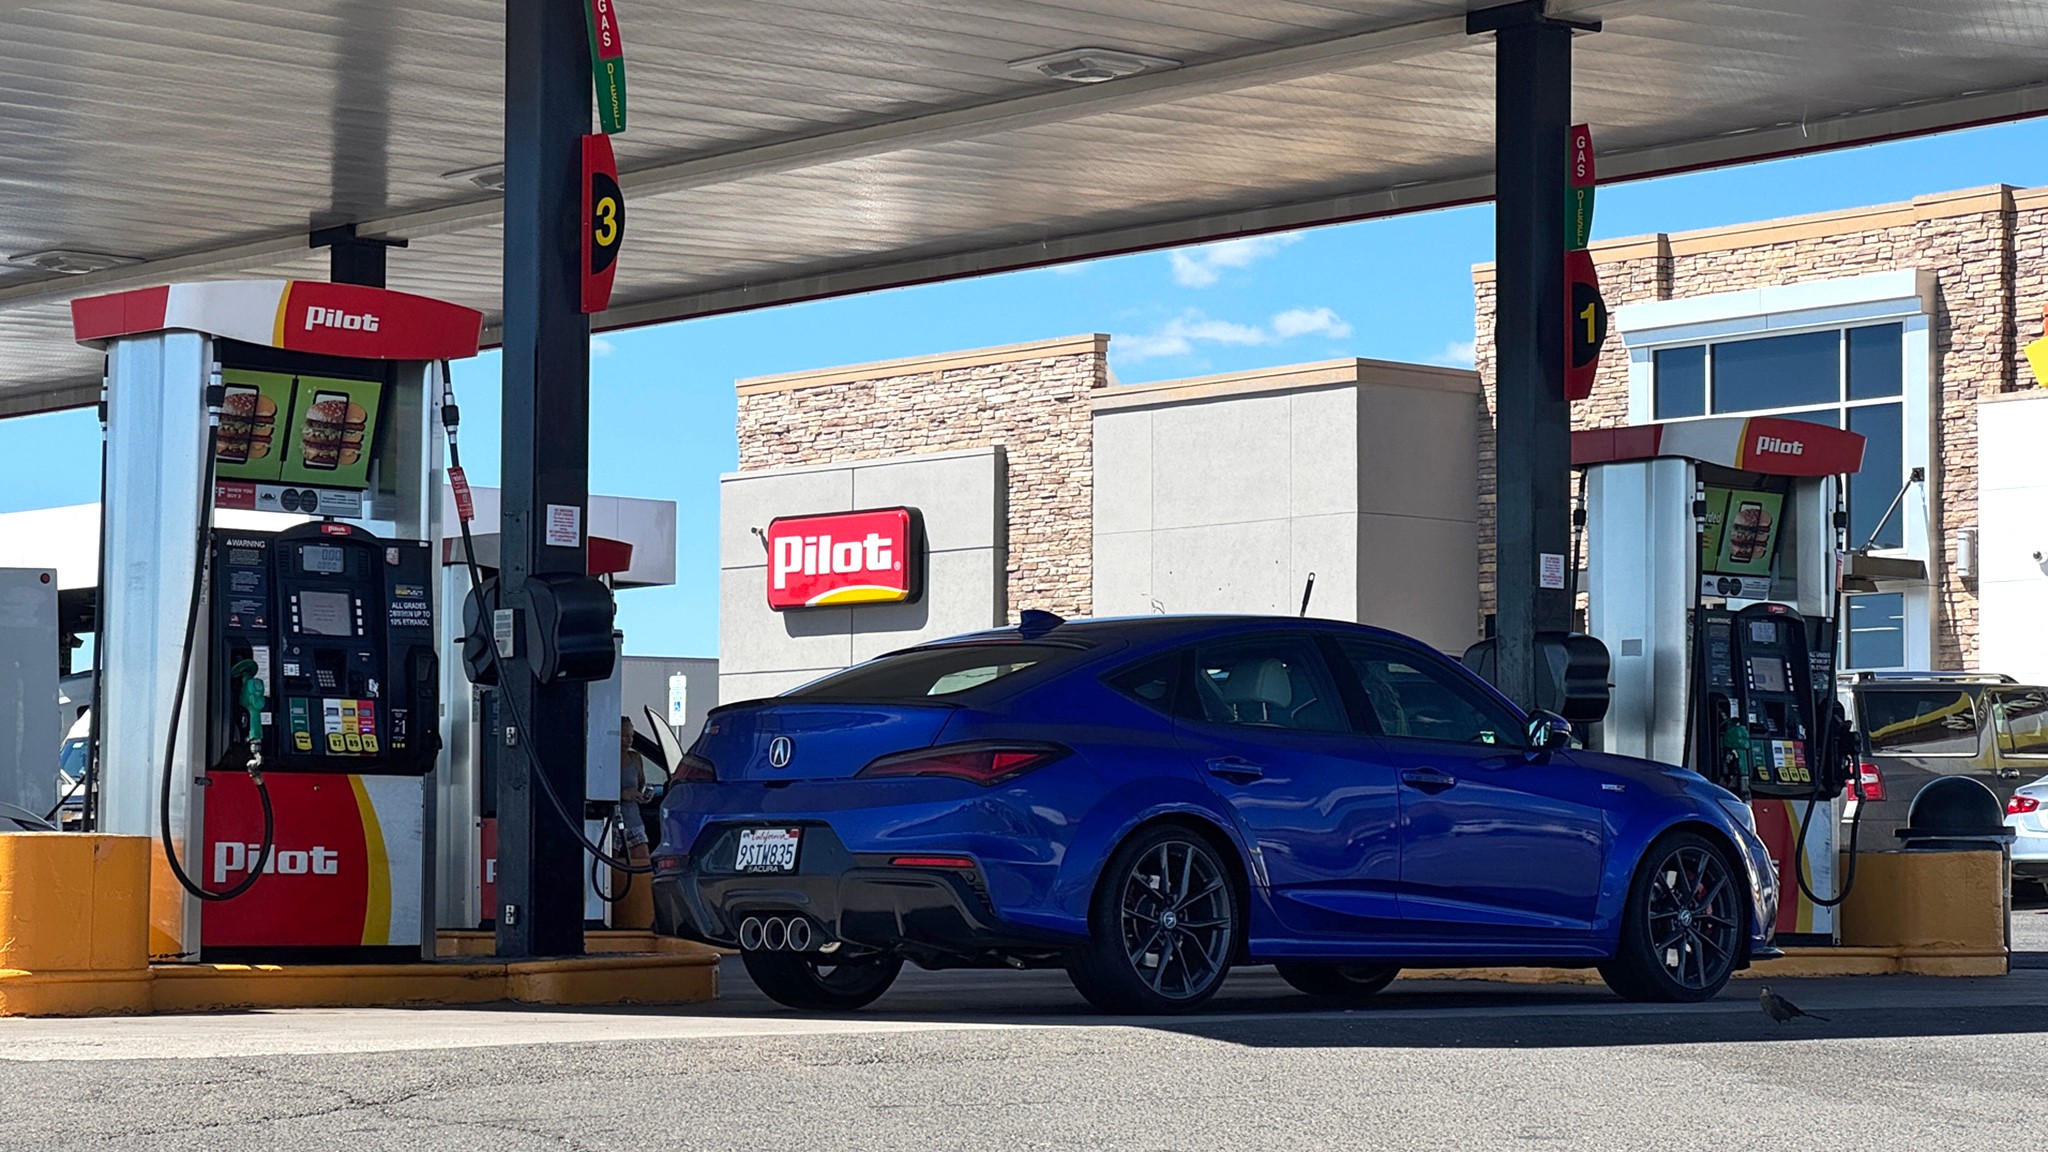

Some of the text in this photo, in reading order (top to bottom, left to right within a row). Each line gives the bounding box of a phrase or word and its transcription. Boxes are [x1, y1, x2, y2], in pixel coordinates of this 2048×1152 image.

[597, 0, 612, 47] GAS
[606, 62, 622, 129] DIESEL
[1576, 135, 1586, 177] GAS
[595, 196, 617, 246] 3
[304, 305, 380, 332] Pilot
[1580, 302, 1595, 343] 1
[1755, 435, 1804, 455] Pilot
[231, 539, 266, 549] WARNING
[773, 533, 892, 590] Pilot
[403, 602, 427, 610] GRADES
[332, 739, 341, 748] 87
[349, 739, 359, 748] 89
[365, 740, 375, 748] 91
[213, 841, 338, 883] Pilot
